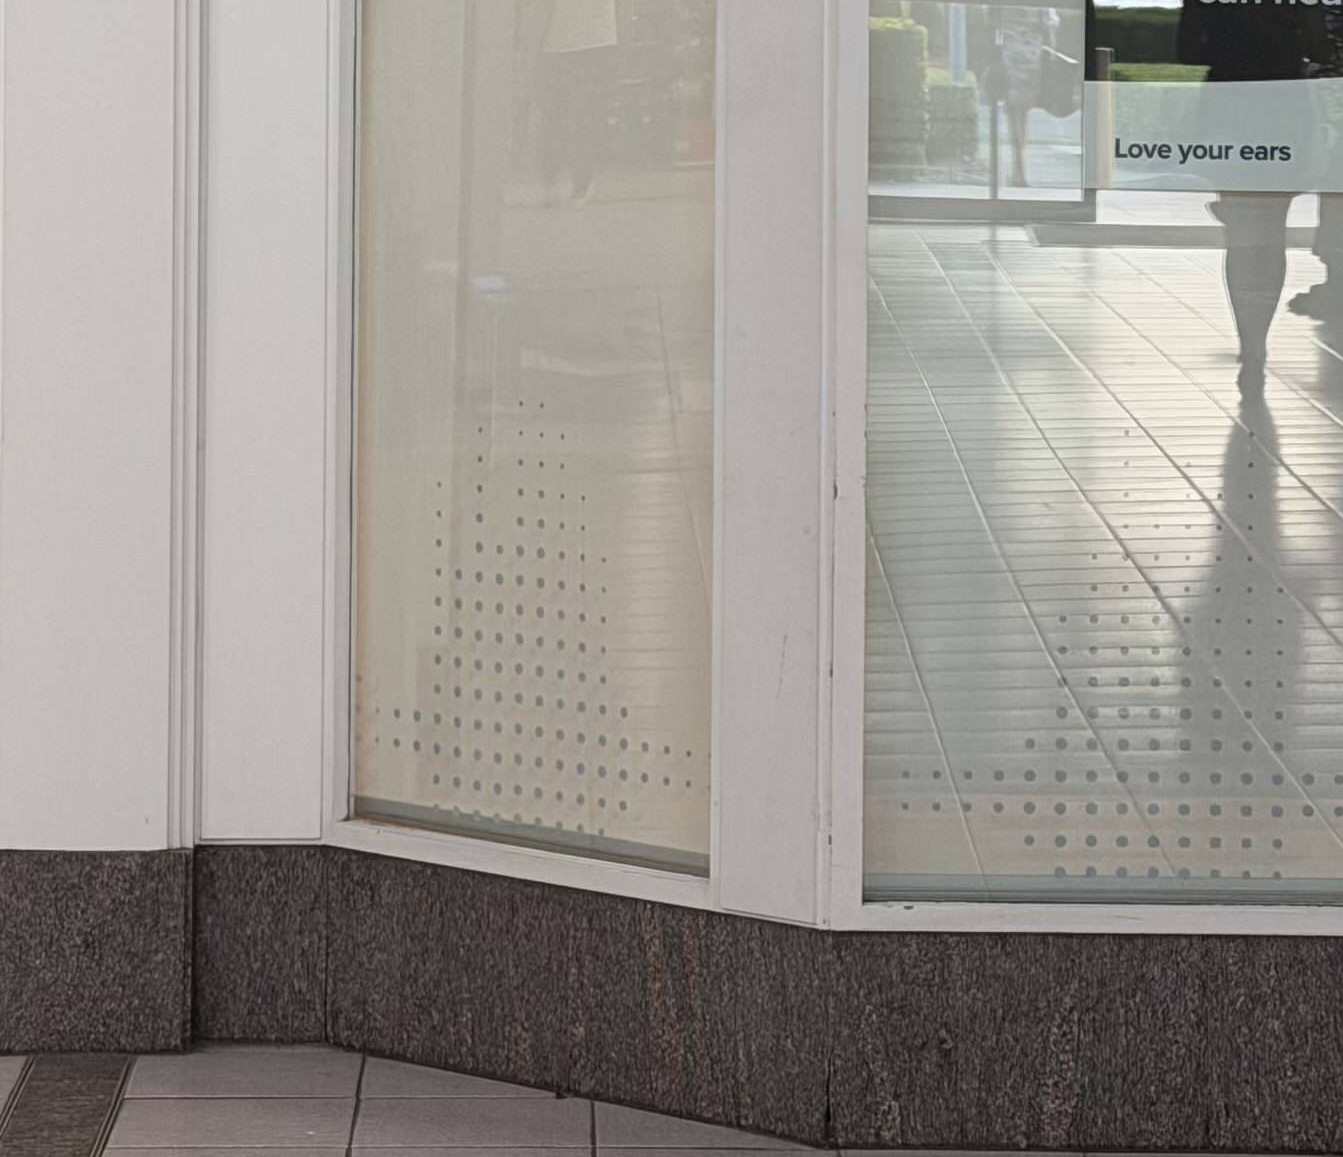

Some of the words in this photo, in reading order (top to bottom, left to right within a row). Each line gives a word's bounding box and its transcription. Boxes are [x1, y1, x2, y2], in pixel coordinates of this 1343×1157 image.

[1114, 138, 1172, 159] Love
[1178, 144, 1234, 165] your
[1239, 145, 1292, 161] ears
